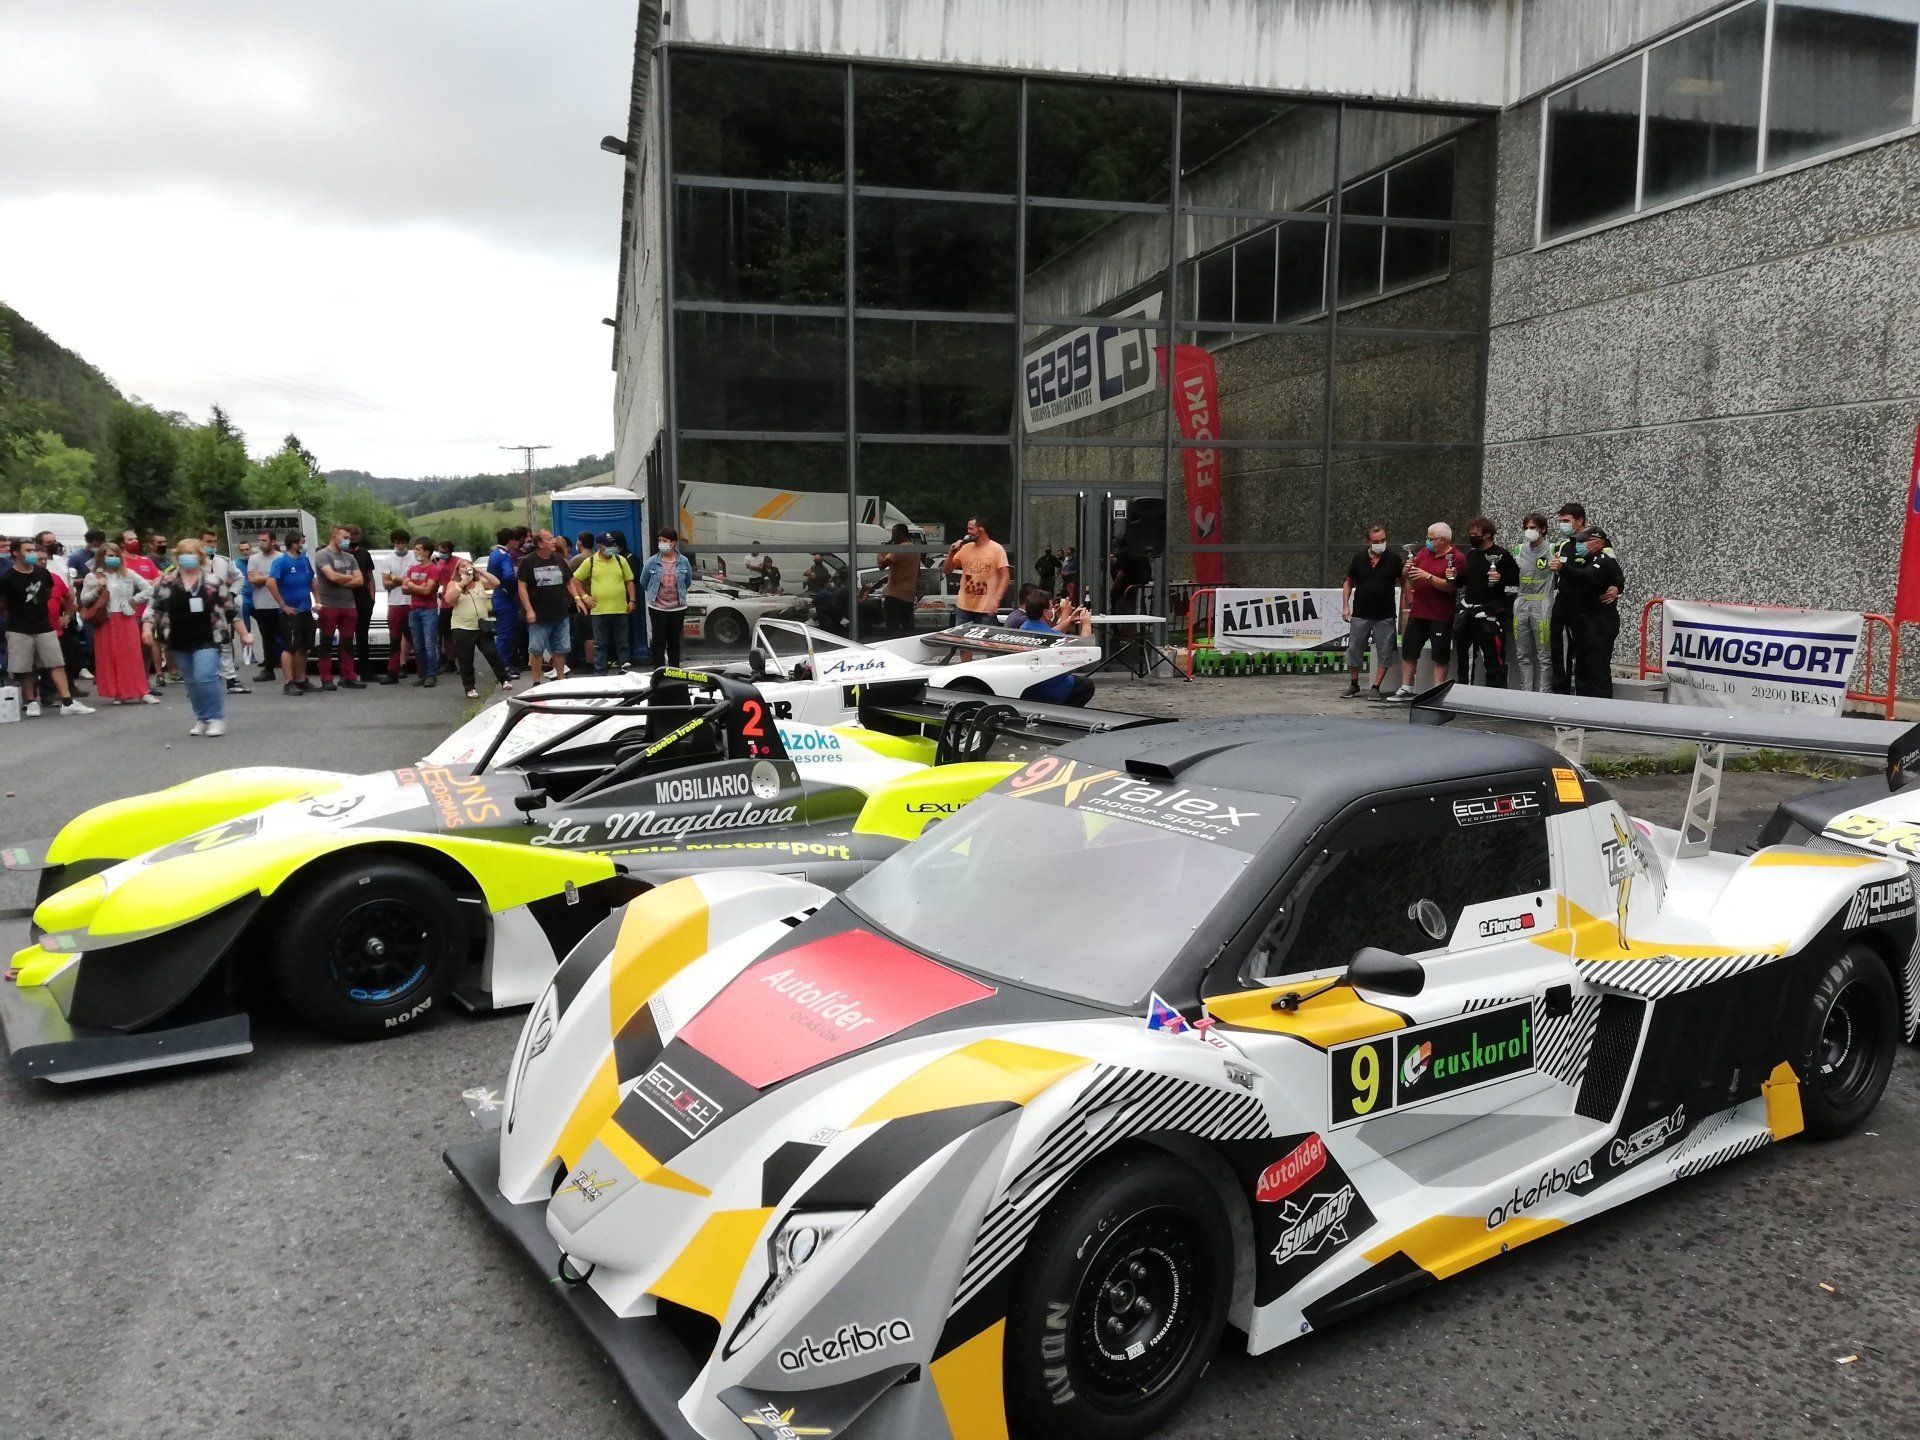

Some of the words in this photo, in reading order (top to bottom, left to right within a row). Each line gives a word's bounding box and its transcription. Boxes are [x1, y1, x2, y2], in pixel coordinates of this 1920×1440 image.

[823, 659, 886, 675] Araba
[1669, 632, 1854, 675] ALMOSPORT
[850, 684, 861, 707] 1
[1722, 681, 1736, 694] 10
[1751, 685, 1787, 702] 20200
[1791, 690, 1842, 708] BEASA
[742, 700, 764, 736] 2
[778, 729, 841, 750] Azoka
[655, 773, 749, 803] MOBILIARIO
[1011, 757, 1059, 788] 9
[906, 803, 968, 813] LEXU
[1087, 797, 1158, 815] motor
[1160, 811, 1234, 836] sport
[1101, 777, 1262, 827] Talex
[1461, 810, 1527, 823] PERFORMANCE
[530, 818, 591, 846] La
[605, 802, 797, 840] Magdalena
[1078, 804, 1217, 842] www.talexmotorsport.es
[686, 841, 851, 861] Motorsport
[384, 996, 432, 1028] AVON
[1350, 1044, 1380, 1115] 9
[643, 1083, 693, 1123] PERFORMANCE
[1609, 1104, 1686, 1167] CASAL
[1487, 1160, 1590, 1229] artefibra
[1279, 1189, 1349, 1260] SUNOCO
[779, 1320, 911, 1371] artefibra
